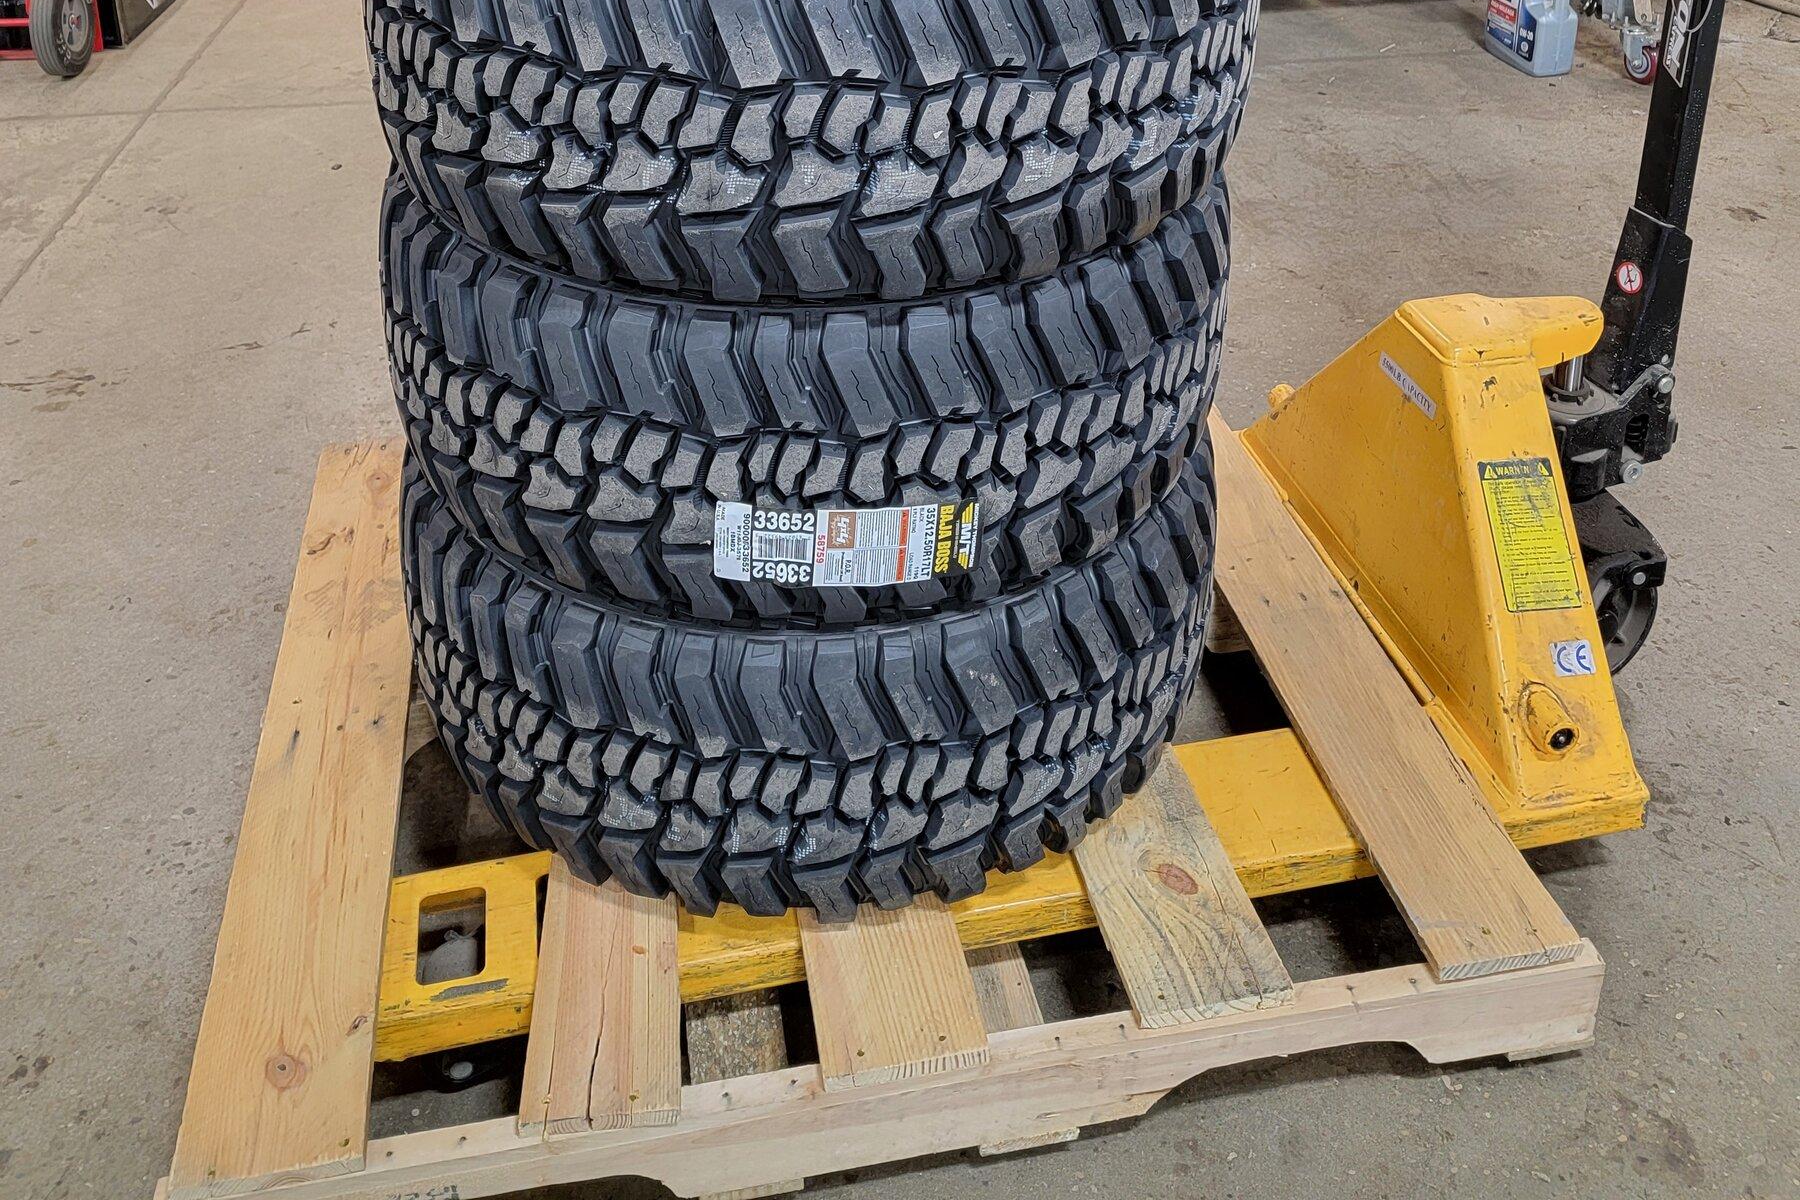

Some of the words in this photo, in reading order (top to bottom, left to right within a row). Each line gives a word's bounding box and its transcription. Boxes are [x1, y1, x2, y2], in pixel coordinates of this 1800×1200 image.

[753, 510, 815, 532] 33652
[938, 504, 955, 540] BAJA
[816, 534, 826, 564] 58759
[920, 507, 936, 577] 35X12.50R17LT
[934, 540, 952, 573] BOSS
[752, 561, 811, 584] 33652
